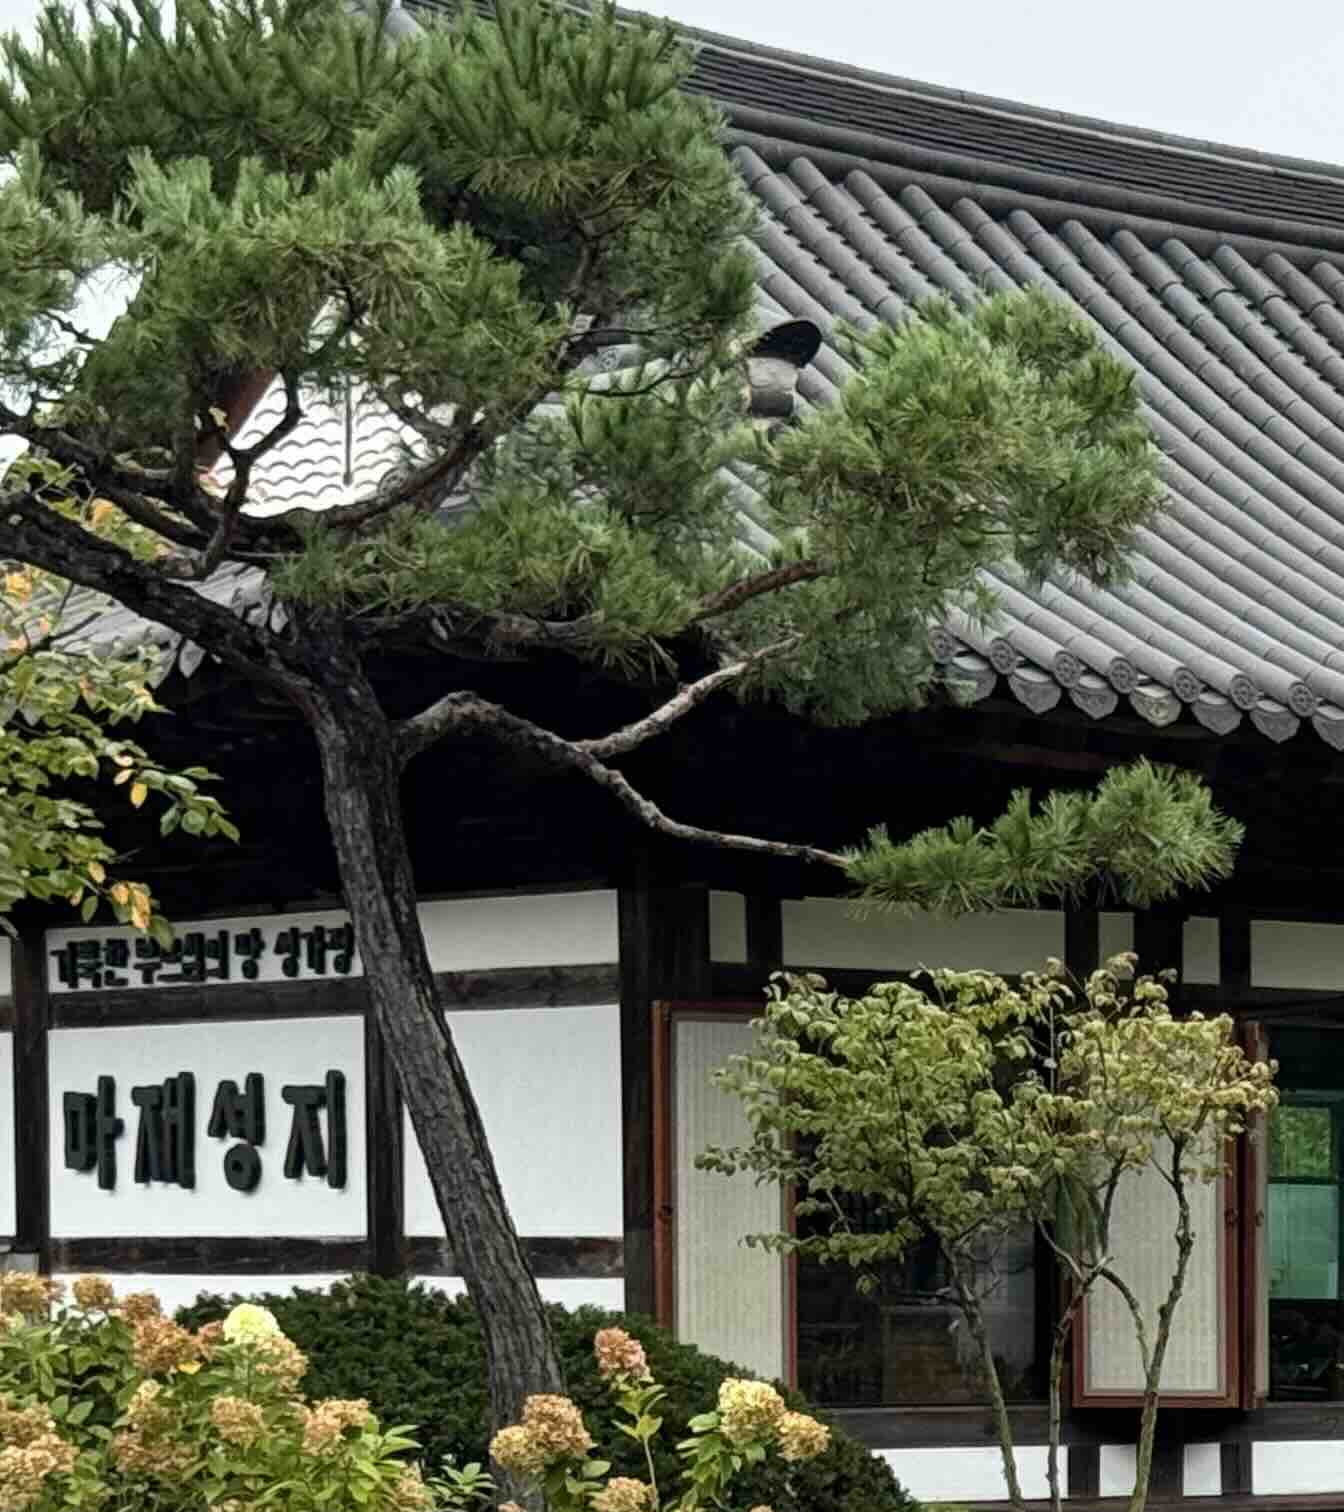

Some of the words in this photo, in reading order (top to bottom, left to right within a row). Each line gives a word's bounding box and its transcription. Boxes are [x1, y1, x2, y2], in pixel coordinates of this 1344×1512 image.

[50, 937, 130, 989] 거룩한
[273, 922, 355, 977] 성가정
[64, 1070, 347, 1194] 마재성지
